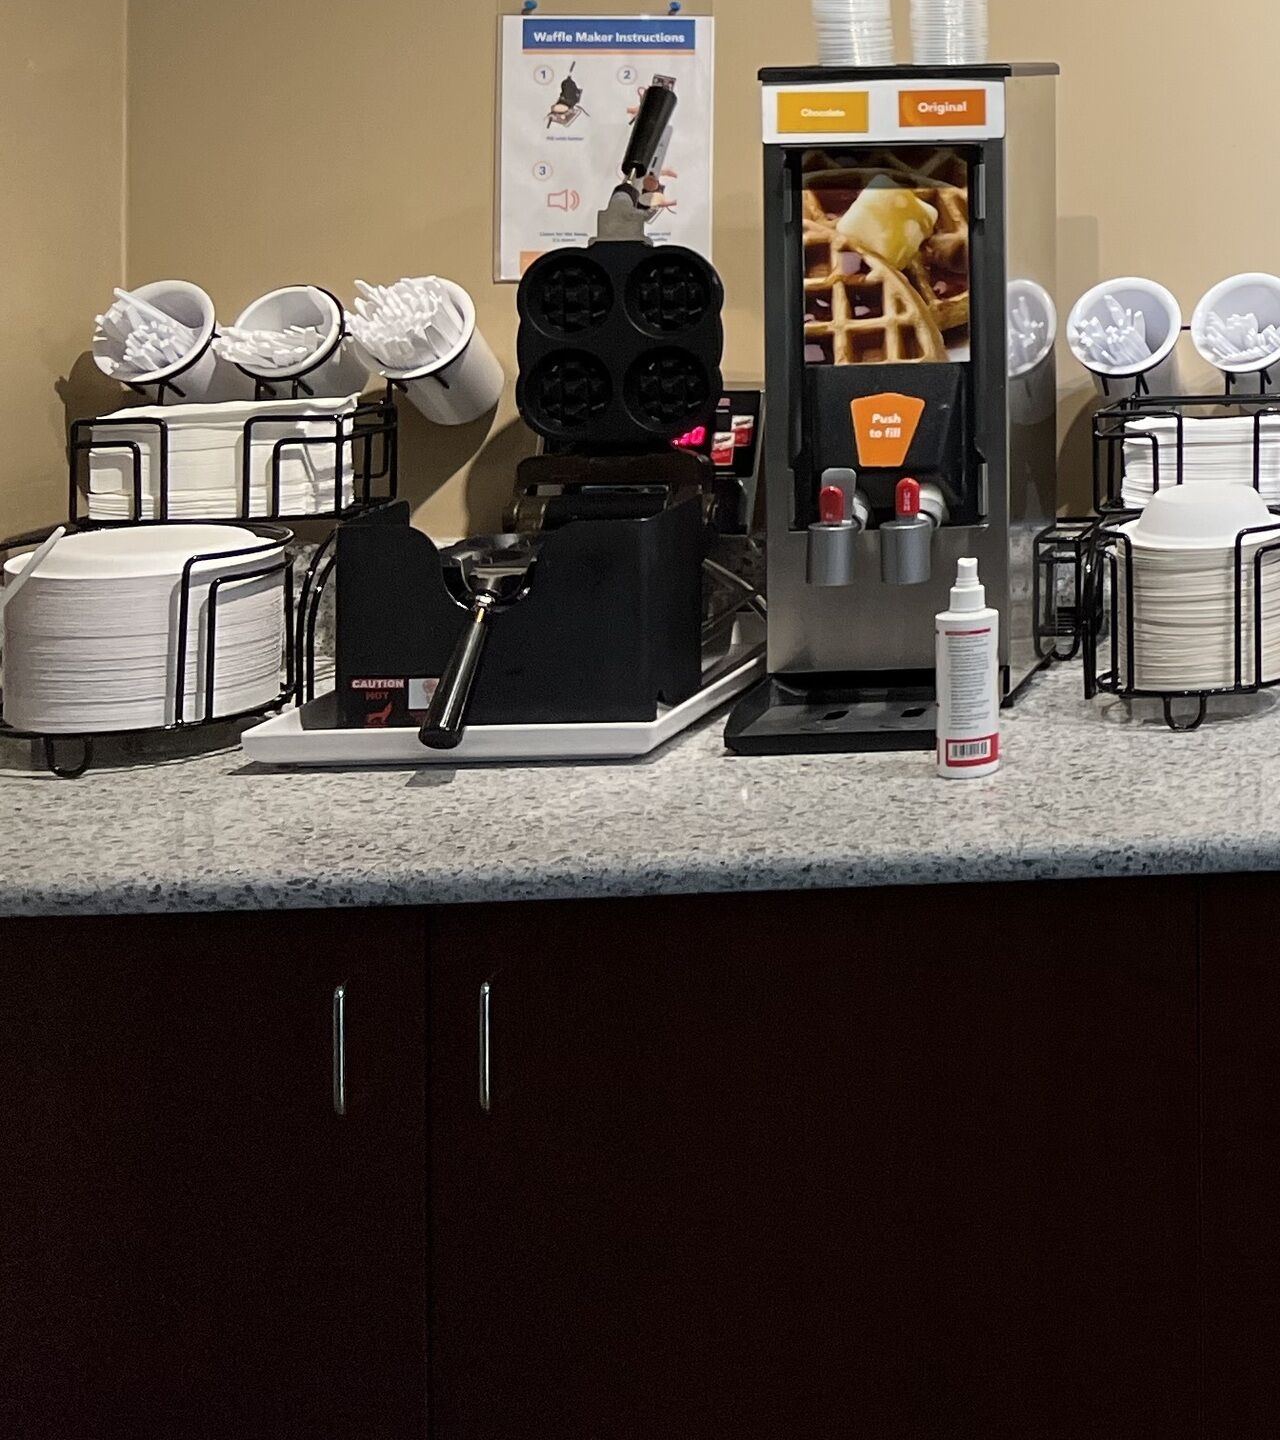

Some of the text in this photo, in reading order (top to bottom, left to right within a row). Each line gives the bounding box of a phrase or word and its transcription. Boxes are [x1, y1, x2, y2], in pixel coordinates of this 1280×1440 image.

[533, 30, 686, 44] Waffle Maker Instructions
[540, 69, 632, 80] 1 2
[917, 101, 967, 116] Original
[539, 165, 546, 176] 3
[872, 413, 902, 424] Push
[869, 427, 901, 438] to fill
[351, 679, 405, 689] CAUTION
[365, 691, 389, 700] HOT
